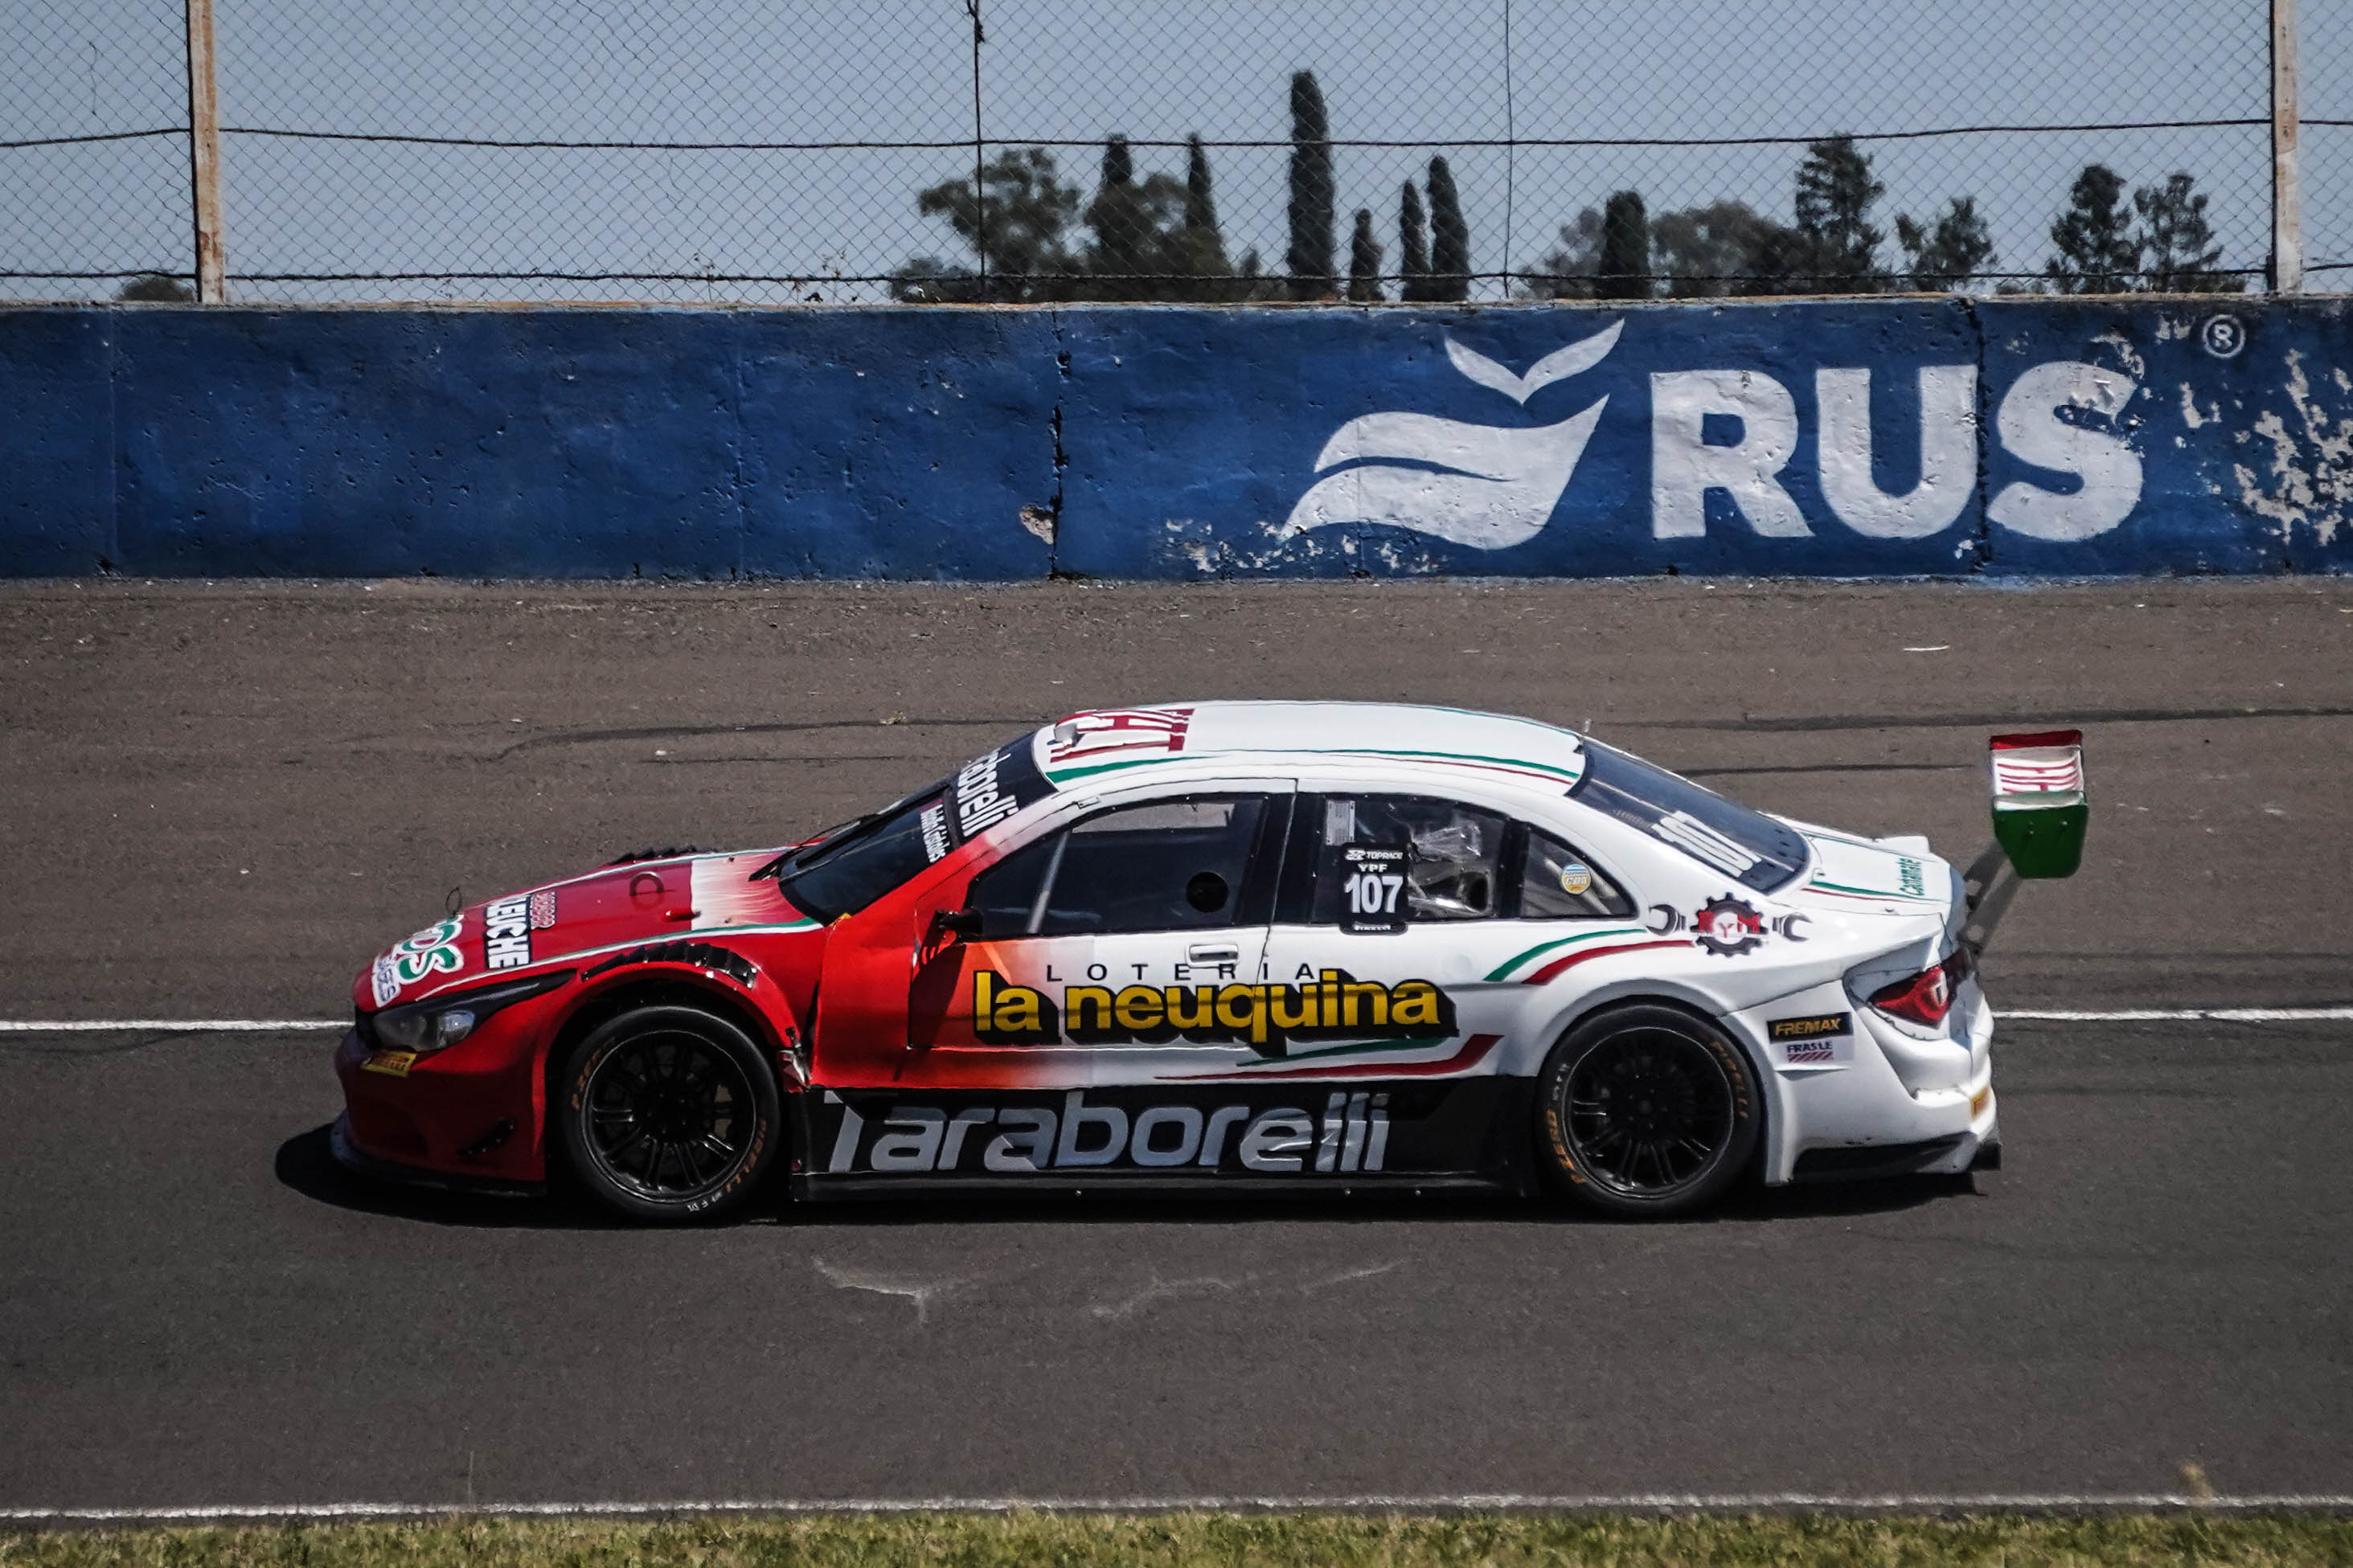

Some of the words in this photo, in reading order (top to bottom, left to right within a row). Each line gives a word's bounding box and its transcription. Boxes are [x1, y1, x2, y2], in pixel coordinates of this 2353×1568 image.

[1650, 364, 2144, 542] RUS
[1358, 863, 1388, 872] YPF
[1344, 874, 1404, 914] 107
[974, 970, 1043, 1032] la
[1064, 969, 1441, 1044] neuquina
[1775, 1017, 1841, 1036] FREMAX
